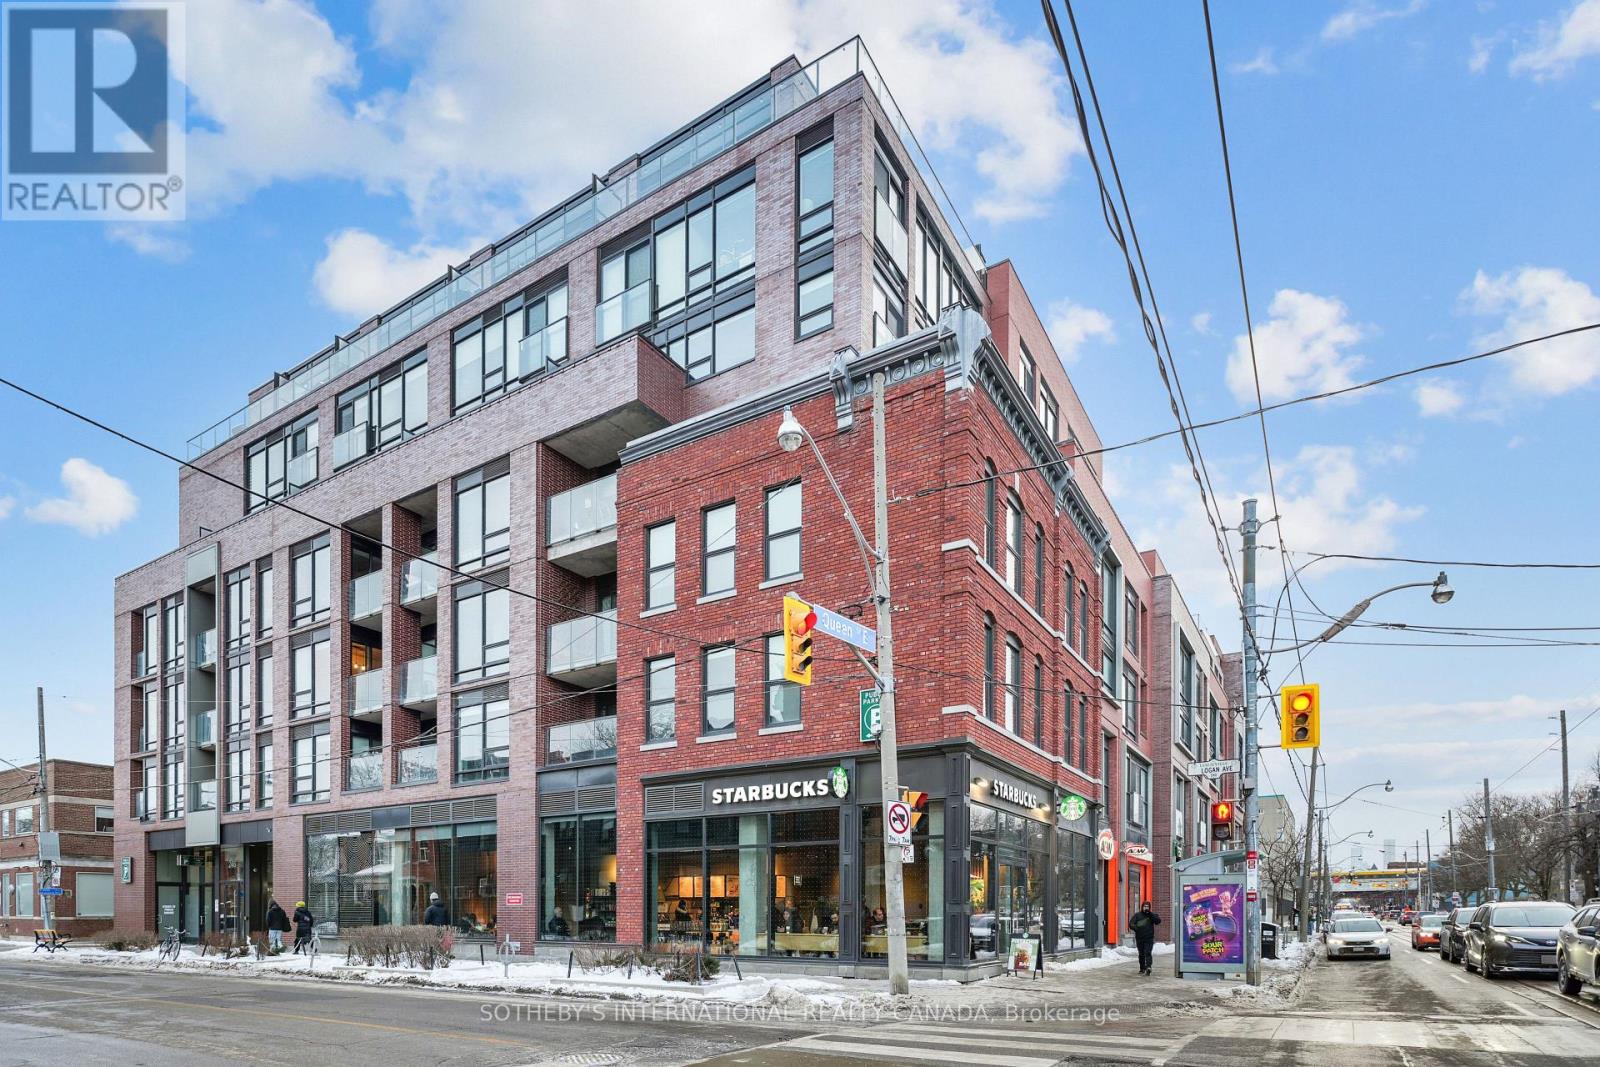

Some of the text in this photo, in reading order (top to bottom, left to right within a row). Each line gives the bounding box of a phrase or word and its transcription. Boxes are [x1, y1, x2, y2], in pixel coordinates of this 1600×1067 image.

[822, 612, 853, 638] Queen
[1201, 766, 1220, 774] LOGAN
[712, 779, 829, 804] STARBUCKS
[993, 779, 1037, 809] STARBUCKS
[1202, 941, 1223, 949] SOUR
[1202, 947, 1224, 955] PATCH
